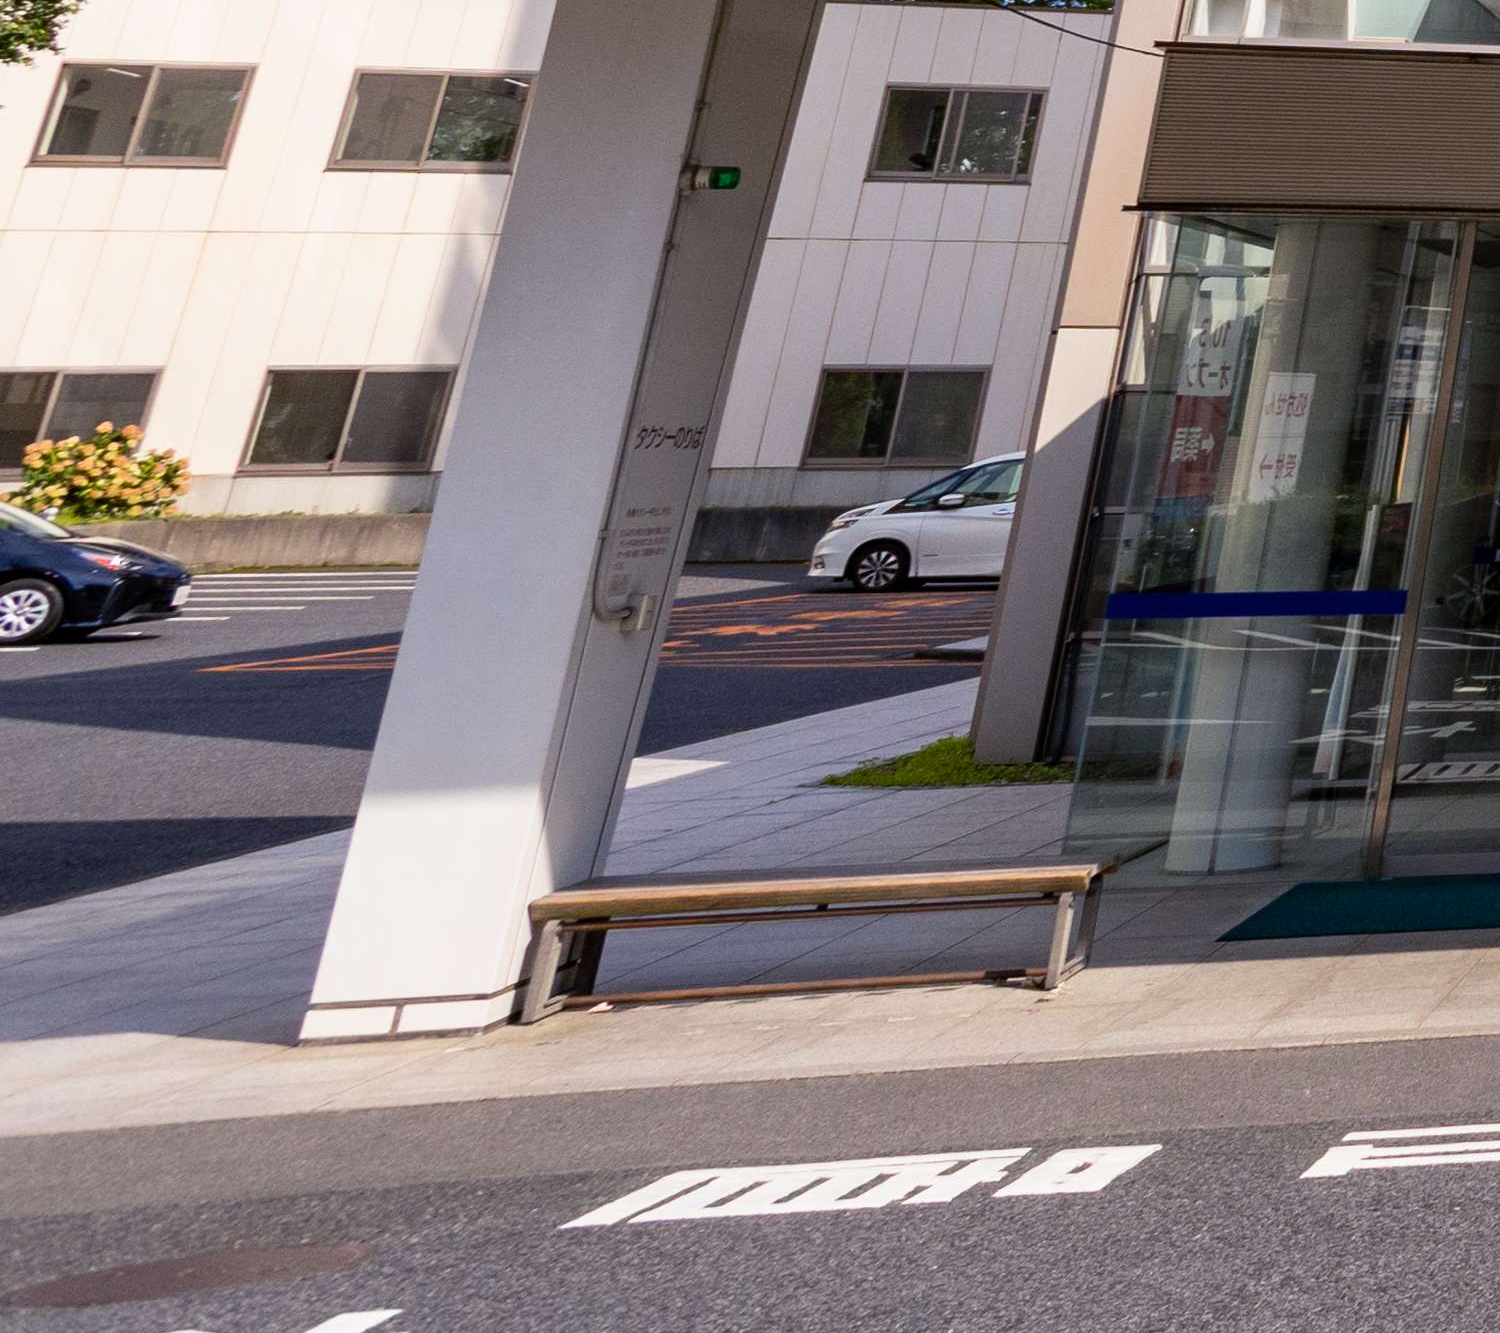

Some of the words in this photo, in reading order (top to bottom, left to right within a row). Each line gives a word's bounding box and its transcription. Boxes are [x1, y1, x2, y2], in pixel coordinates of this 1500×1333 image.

[634, 425, 706, 450] タクシーのりば
